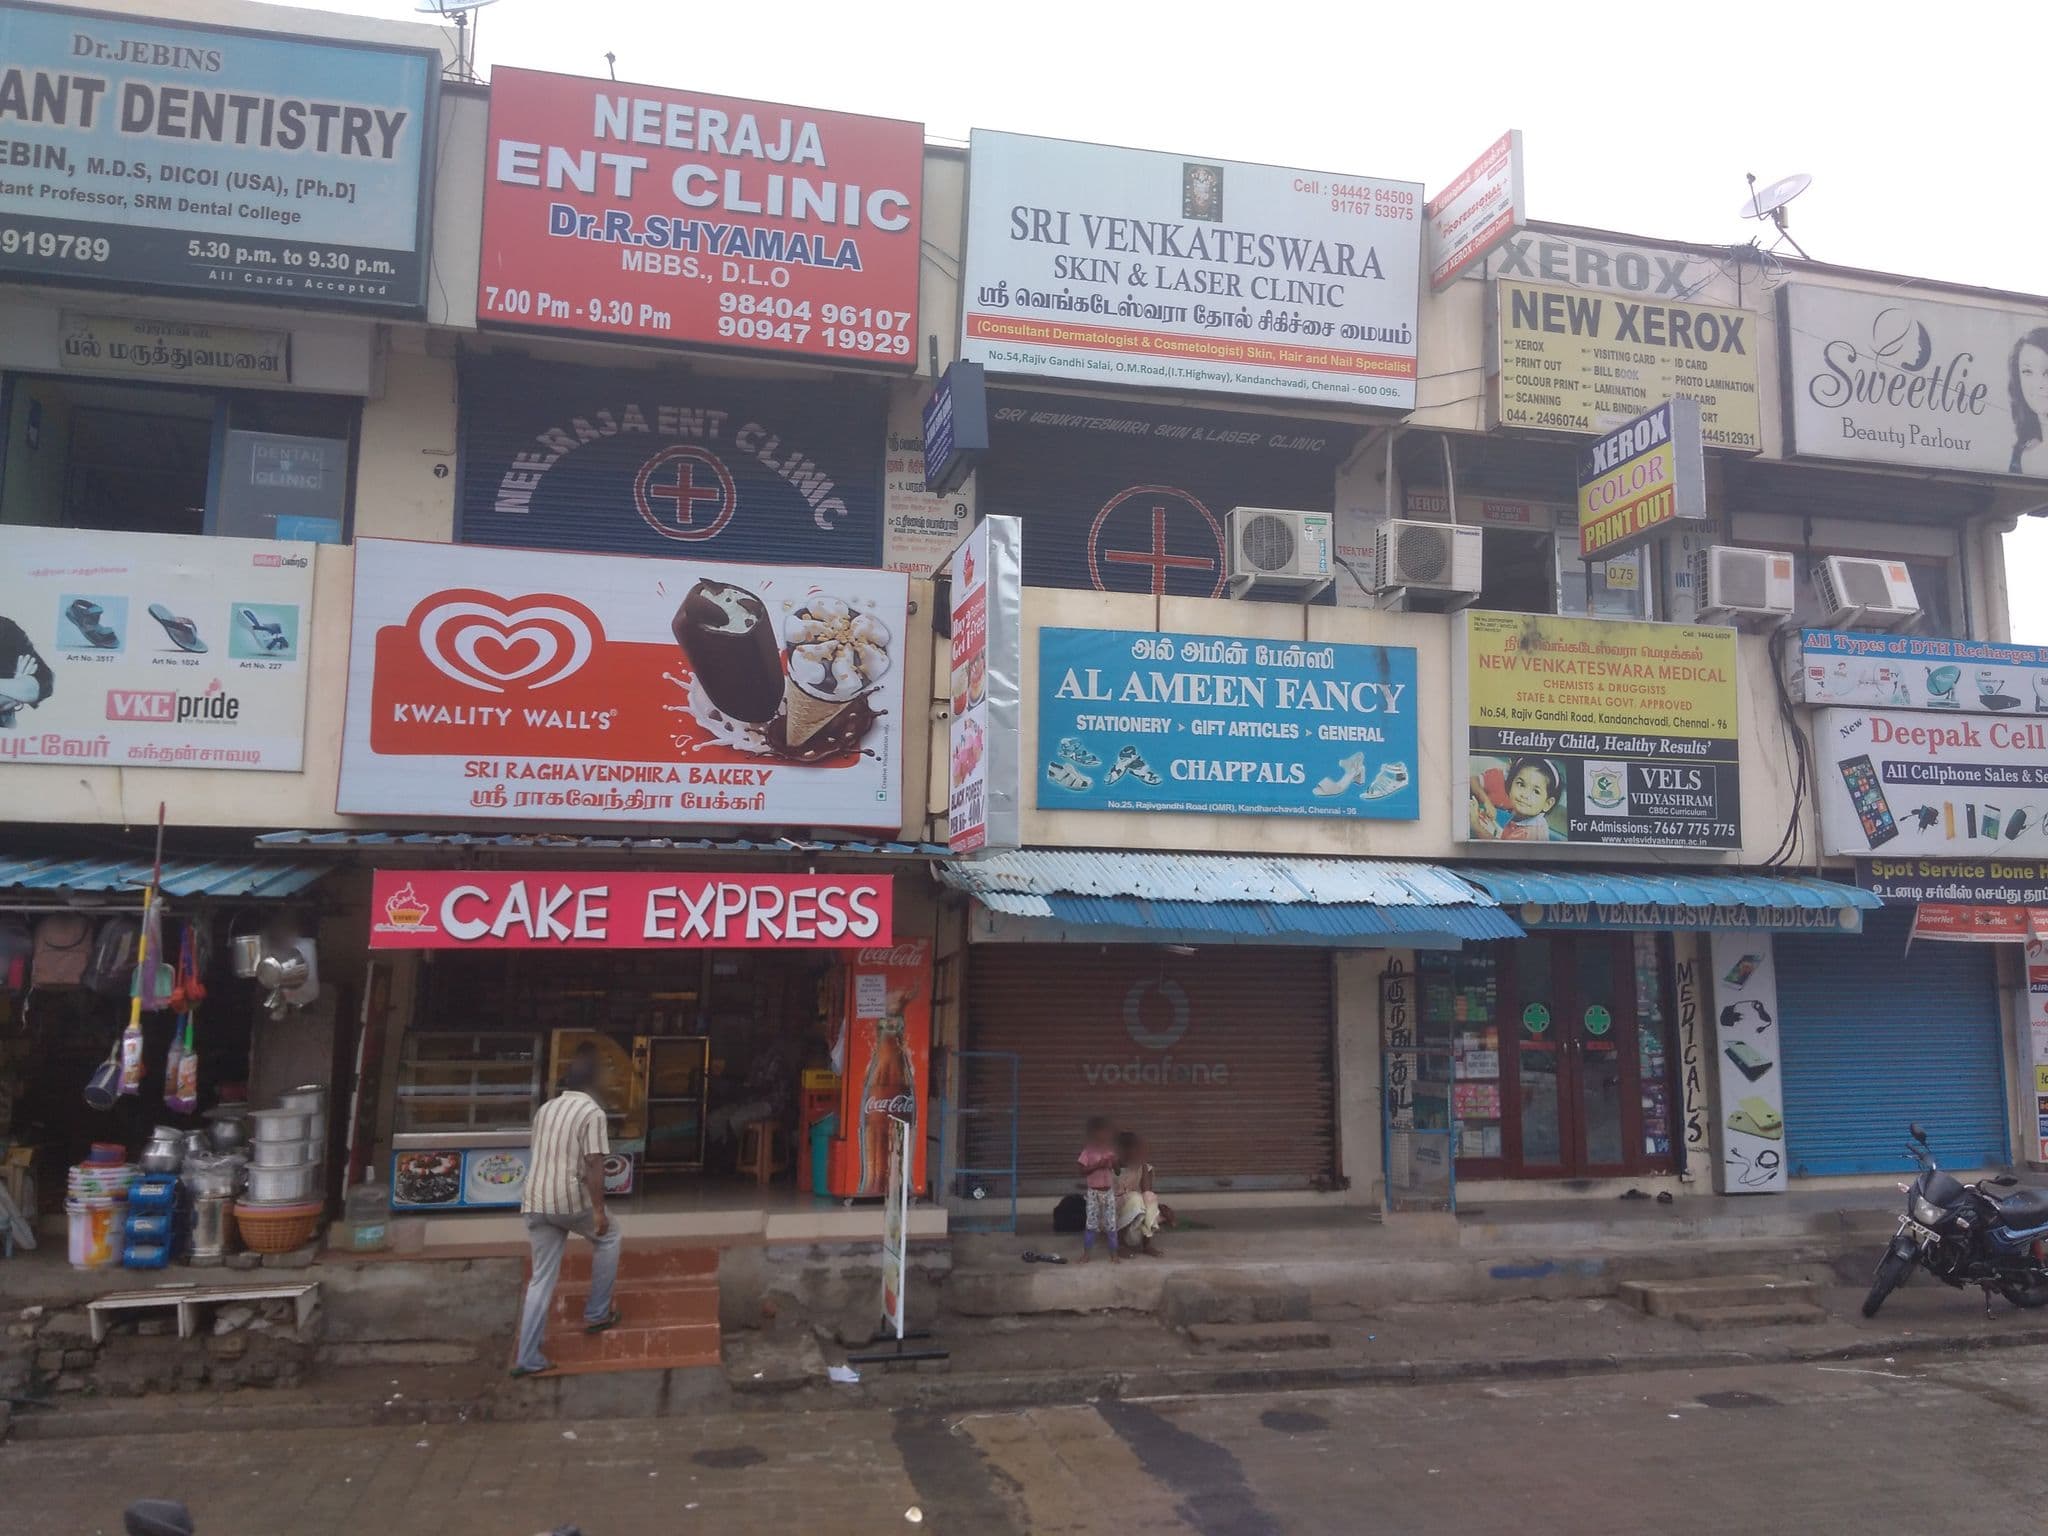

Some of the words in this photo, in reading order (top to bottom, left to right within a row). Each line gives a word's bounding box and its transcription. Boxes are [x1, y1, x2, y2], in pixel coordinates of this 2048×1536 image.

[73, 34, 222, 73] Dr.JEBINS
[121, 82, 407, 159] DENTISTRY
[594, 94, 826, 168] NEERAJA
[87, 157, 152, 182] M.D.S,
[160, 165, 218, 186] DICOI
[226, 171, 288, 197] (USA),
[296, 178, 356, 203] [Ph.D]
[496, 139, 648, 198] ENT
[671, 164, 911, 231] CLINIC
[1294, 178, 1319, 195] Cell
[1331, 182, 1371, 200] 94442
[1374, 187, 1414, 205] 64509
[40, 185, 127, 209] Professor,
[134, 194, 172, 211] SRM
[179, 199, 232, 217] Dental
[238, 204, 301, 224] College
[1331, 199, 1371, 215] 91767
[1374, 203, 1414, 221] 53975
[0, 229, 110, 262] 919789
[549, 204, 862, 272] Dr.R.SHYAMALA
[1010, 205, 1070, 246] SRI
[1079, 214, 1386, 281] VENKATESWARA
[188, 240, 230, 260] 5.30
[236, 247, 277, 265] p.m.
[283, 247, 302, 266] to
[308, 252, 349, 271] 9.30
[356, 257, 396, 276] p.m.
[1497, 237, 1691, 296] XEROX
[209, 270, 233, 281] All
[244, 273, 293, 287] Cards
[305, 279, 387, 295] Accepted
[1054, 254, 1121, 287] SKIN
[1128, 262, 1148, 288] &
[1155, 265, 1242, 298] LASER
[1250, 279, 1345, 308] CLINIC
[485, 286, 530, 314] 7.00
[537, 292, 569, 319] Pm
[589, 298, 633, 326] 9.30
[640, 304, 671, 330] Pm
[719, 292, 811, 320] 98404
[821, 302, 910, 331] 96107
[1193, 303, 1253, 332] தோல்
[1341, 320, 1412, 346] மையம்
[1511, 289, 1602, 338] NEW
[1614, 302, 1746, 356] XEROX
[718, 316, 810, 345] 90947
[822, 325, 910, 355] 19929
[977, 319, 1050, 340] (Consultant
[1052, 326, 1139, 349] Dermatologist
[1141, 334, 1151, 348] &
[1154, 336, 1244, 359] Cosmetologist)
[1279, 349, 1301, 363] Hair
[1304, 351, 1328, 366] and
[1330, 353, 1352, 367] Nail
[1354, 355, 1411, 374] Specialist
[1592, 408, 1668, 476] XEROX
[1841, 416, 1905, 449] Beauty
[1908, 426, 1972, 452] Parlour
[494, 404, 651, 515] NEERAJA
[657, 405, 729, 440] ENT
[735, 421, 851, 532] CLINIC
[1587, 454, 1664, 513] COLOR
[1584, 502, 1634, 554] PRINT
[1636, 489, 1673, 526] OUT
[1609, 567, 1634, 581] 0.75
[1131, 638, 1175, 661] அல்
[1805, 633, 1831, 648] All
[1834, 634, 1885, 654] Types
[1889, 637, 1907, 654] of
[1911, 640, 1951, 656] DTH
[1479, 654, 1517, 671] NEW
[1523, 658, 1654, 679] VENKATESWARA
[1659, 665, 1727, 683] MEDICAL
[1054, 667, 1113, 701] AL
[1119, 671, 1267, 709] AMEEN
[1275, 678, 1405, 715] FANCY
[1543, 679, 1594, 692] CHEMISTS
[1609, 683, 1666, 695] DRUGGISTS
[112, 693, 171, 718] VKC
[177, 691, 239, 723] pride
[393, 704, 512, 727] KWALITY
[1480, 707, 1508, 720] No.54,
[1511, 708, 1533, 720] Rajiv
[1535, 710, 1568, 722] Gandhi
[1570, 712, 1596, 724] Road,
[1598, 714, 1671, 728] Kandanchavadi,
[1673, 717, 1709, 729] Chennai
[1718, 719, 1727, 730] 96
[1076, 714, 1172, 733] STATIONERY
[1191, 719, 1226, 736] GIFT
[1228, 721, 1299, 739] ARTICLES
[1318, 725, 1384, 742] GENERAL
[1559, 733, 1600, 751] Child,
[1604, 736, 1657, 755] Healthy
[1839, 717, 1863, 739] New
[1869, 717, 1982, 755] Deepak
[1990, 722, 2045, 749] Cell
[464, 761, 498, 779] SRI
[504, 762, 682, 786] RAGHAVENDHIRA
[689, 768, 773, 787] BAKERY
[1170, 759, 1306, 785] CHAPPALS
[1640, 768, 1701, 791] VELS
[1886, 764, 1907, 779] All
[1910, 766, 1981, 784] Cellphone
[1984, 768, 2019, 783] Sales
[2022, 771, 2032, 782] &
[1631, 792, 1713, 808] VIDYASHRAM
[1670, 808, 1707, 817] Curriculum
[1570, 819, 1588, 832] For
[1590, 820, 1652, 834] Admissions:
[1654, 822, 1684, 835] 7667
[1688, 823, 1710, 835] 775
[1714, 824, 1735, 836] 775
[1871, 861, 1913, 878] Spot
[1920, 862, 1985, 879] Service
[1991, 864, 2033, 879] Done
[440, 879, 610, 942] CAKE
[643, 881, 880, 941] EXPRESS
[1547, 904, 1594, 923] NEW
[1599, 904, 1750, 927] VENKATESWARA
[1756, 905, 1836, 927] MEDICAL
[1676, 957, 1703, 1143] MEDICALS
[1082, 1056, 1230, 1087] vodafone
